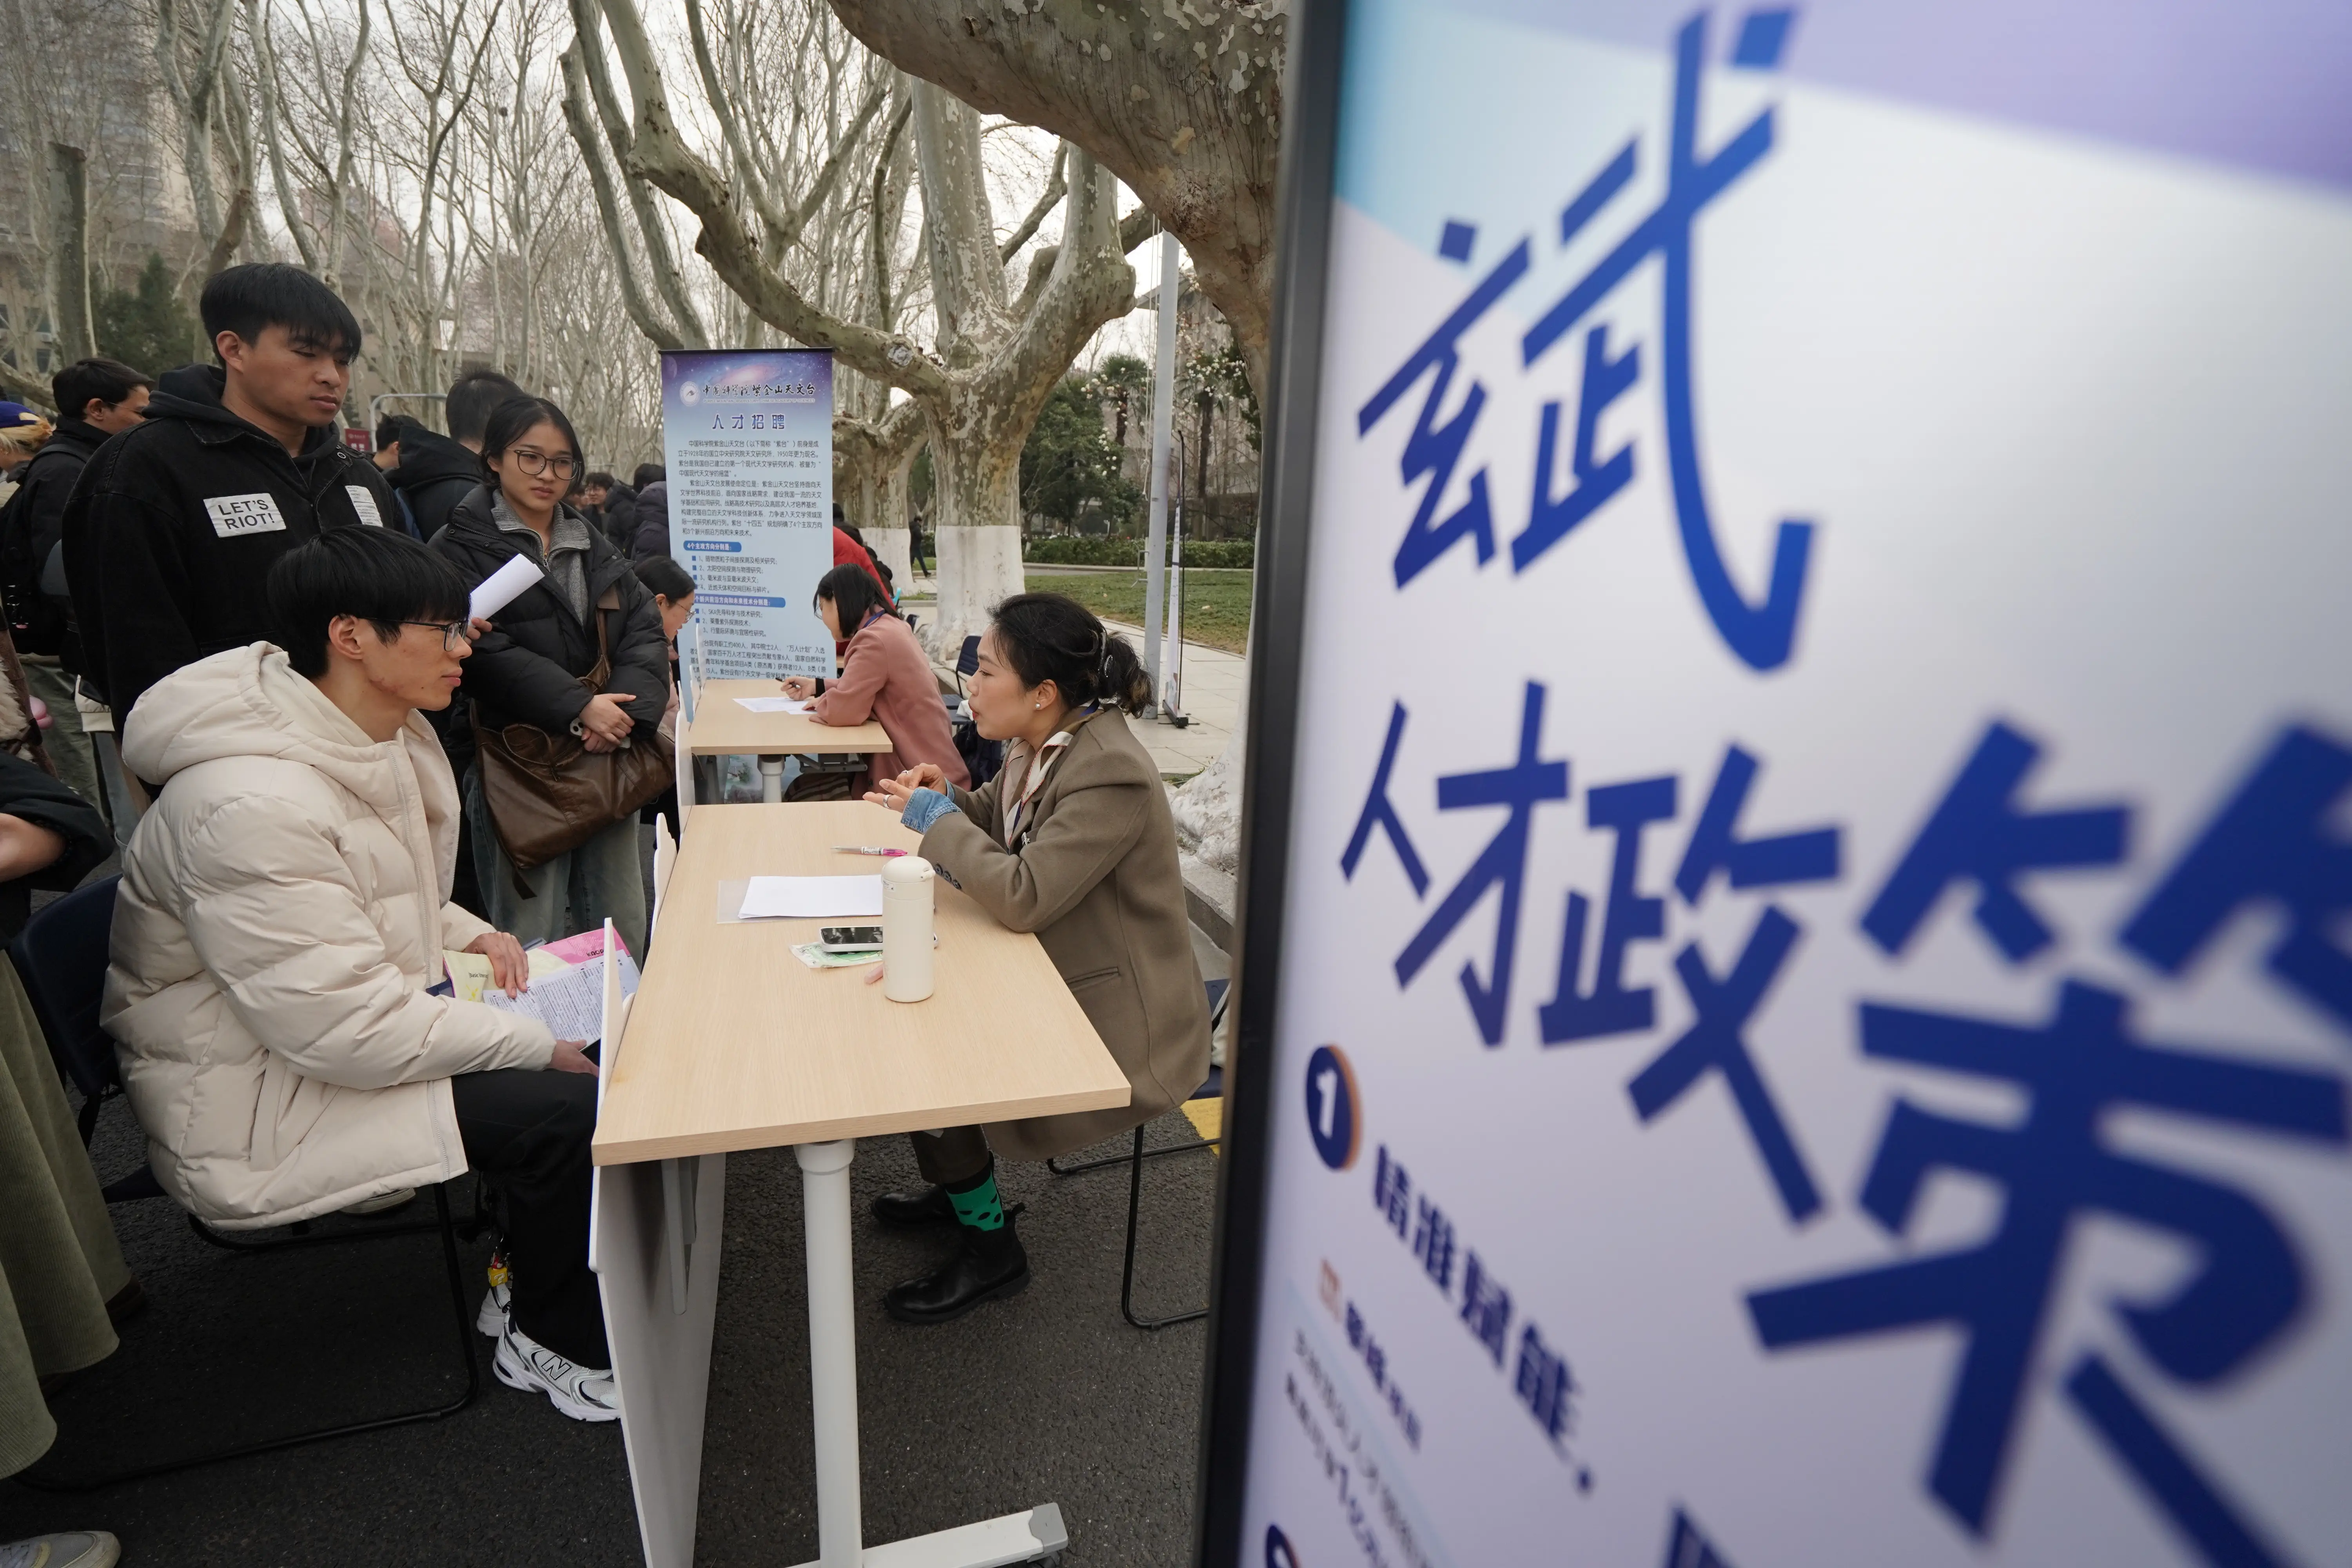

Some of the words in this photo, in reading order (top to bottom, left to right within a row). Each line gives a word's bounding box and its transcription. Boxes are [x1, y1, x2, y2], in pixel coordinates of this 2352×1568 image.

[1358, 6, 1816, 672] 玄武
[703, 383, 816, 396] 中国科学院紫金山天文台
[712, 414, 785, 429] 人才招聘
[218, 500, 269, 515] LET'S
[224, 513, 275, 529] RIOT!
[695, 596, 770, 606] 个新兴前沿方向和未来技术分别是：
[704, 640, 825, 654] 台现有职工约400人，其中院士2人，“万人计划”入选
[1338, 679, 2352, 1568] 人才政策
